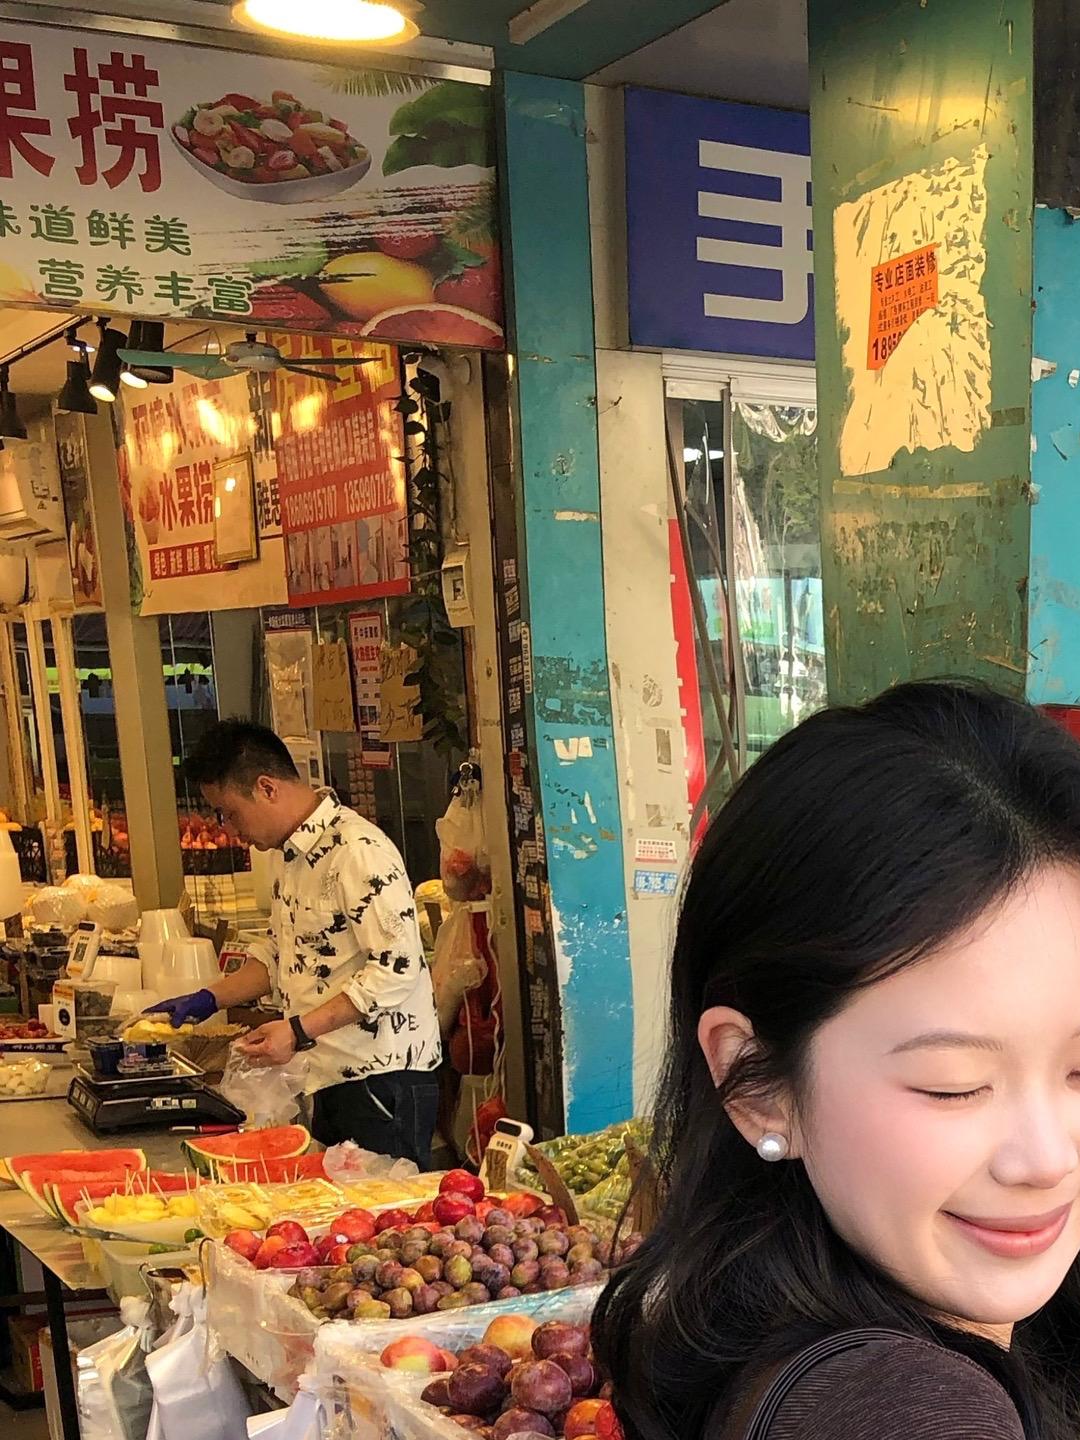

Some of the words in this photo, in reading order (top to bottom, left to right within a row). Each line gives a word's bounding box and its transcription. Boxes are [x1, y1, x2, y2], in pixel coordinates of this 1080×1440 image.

[37, 257, 254, 316] 营养丰富
[874, 251, 936, 293] 专业店面装修
